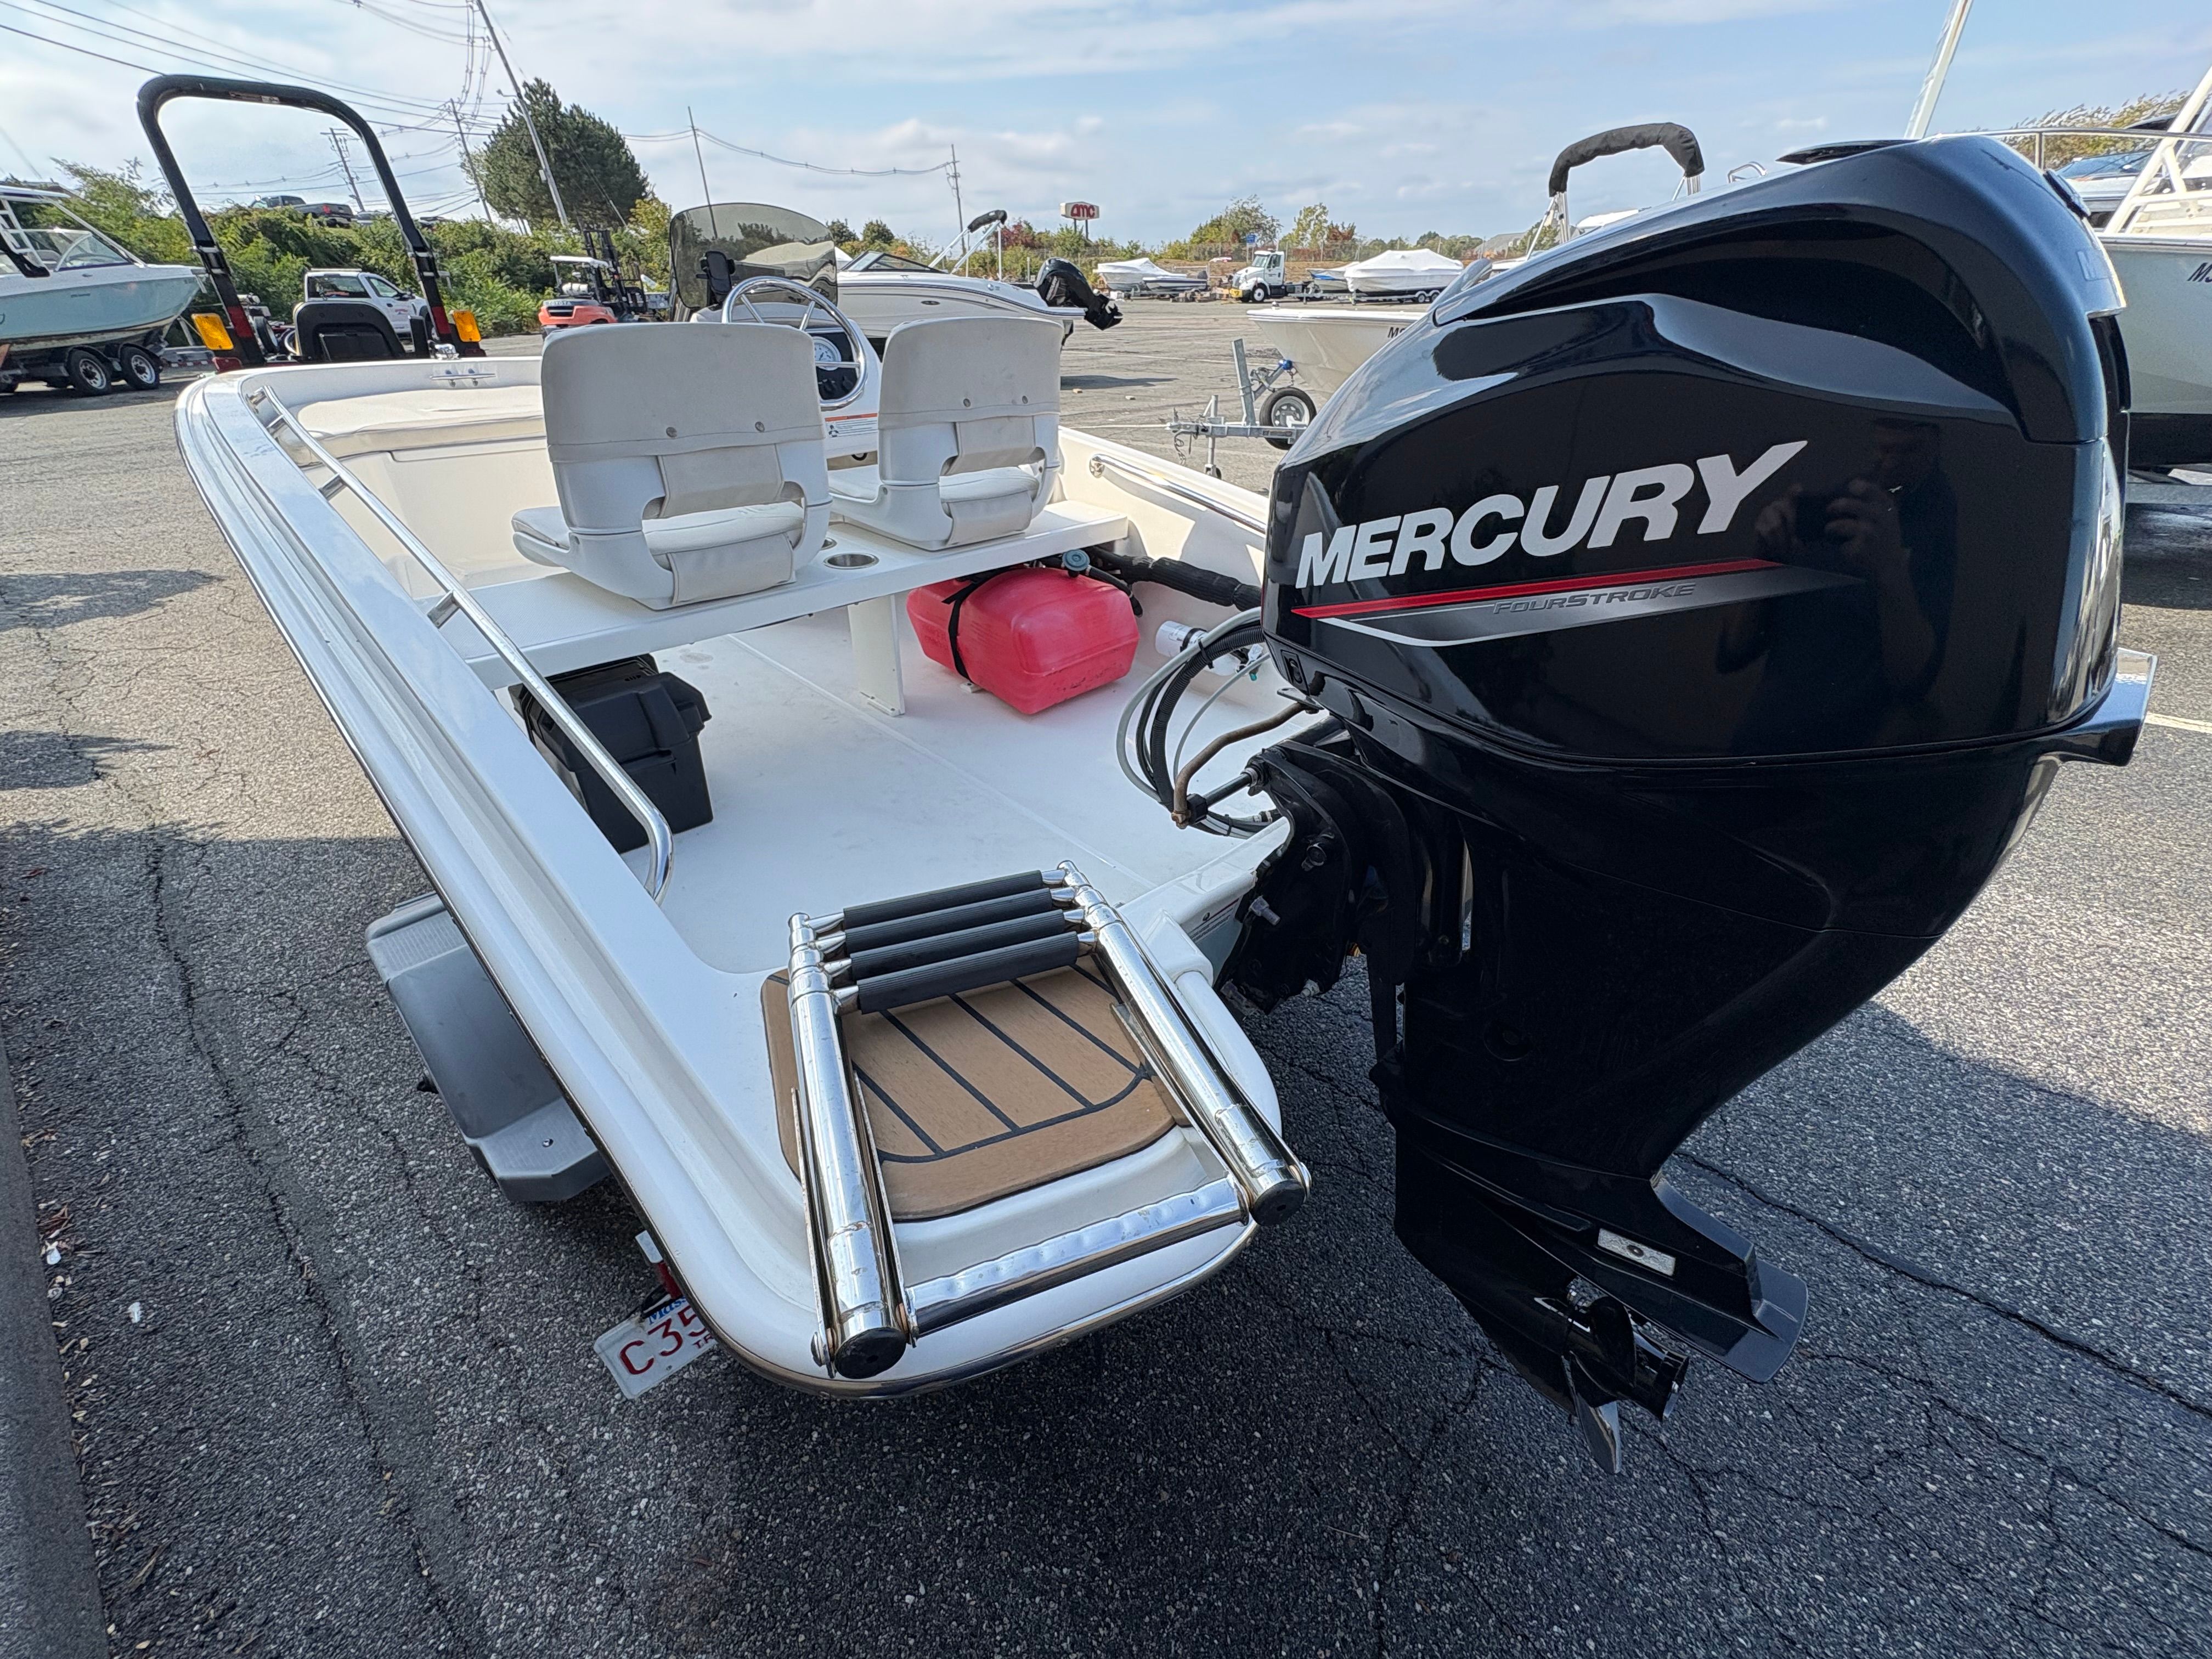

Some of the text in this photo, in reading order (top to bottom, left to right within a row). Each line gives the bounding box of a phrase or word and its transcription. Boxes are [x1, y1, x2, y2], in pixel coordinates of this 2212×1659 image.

[2187, 262, 2212, 283] M
[1295, 441, 1808, 589] MERCURY
[1493, 583, 1696, 613] FOURSTROKE
[619, 1305, 707, 1375] C35
